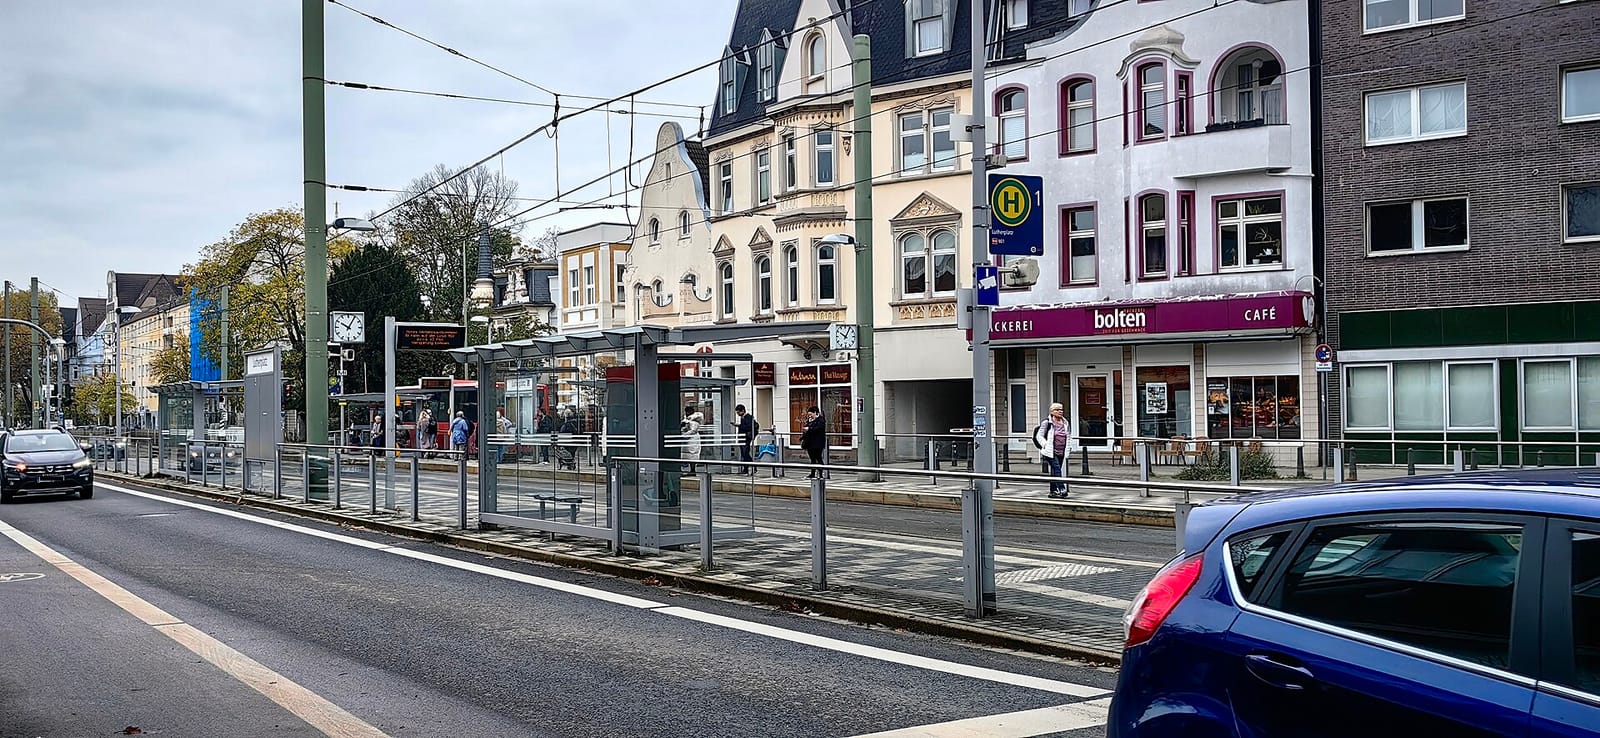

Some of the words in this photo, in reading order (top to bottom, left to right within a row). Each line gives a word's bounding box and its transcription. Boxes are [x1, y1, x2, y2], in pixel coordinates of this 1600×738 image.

[1003, 191, 1020, 213] H
[1034, 190, 1040, 207] 1
[1094, 308, 1146, 328] bolten
[1244, 306, 1276, 321] CAFÉ
